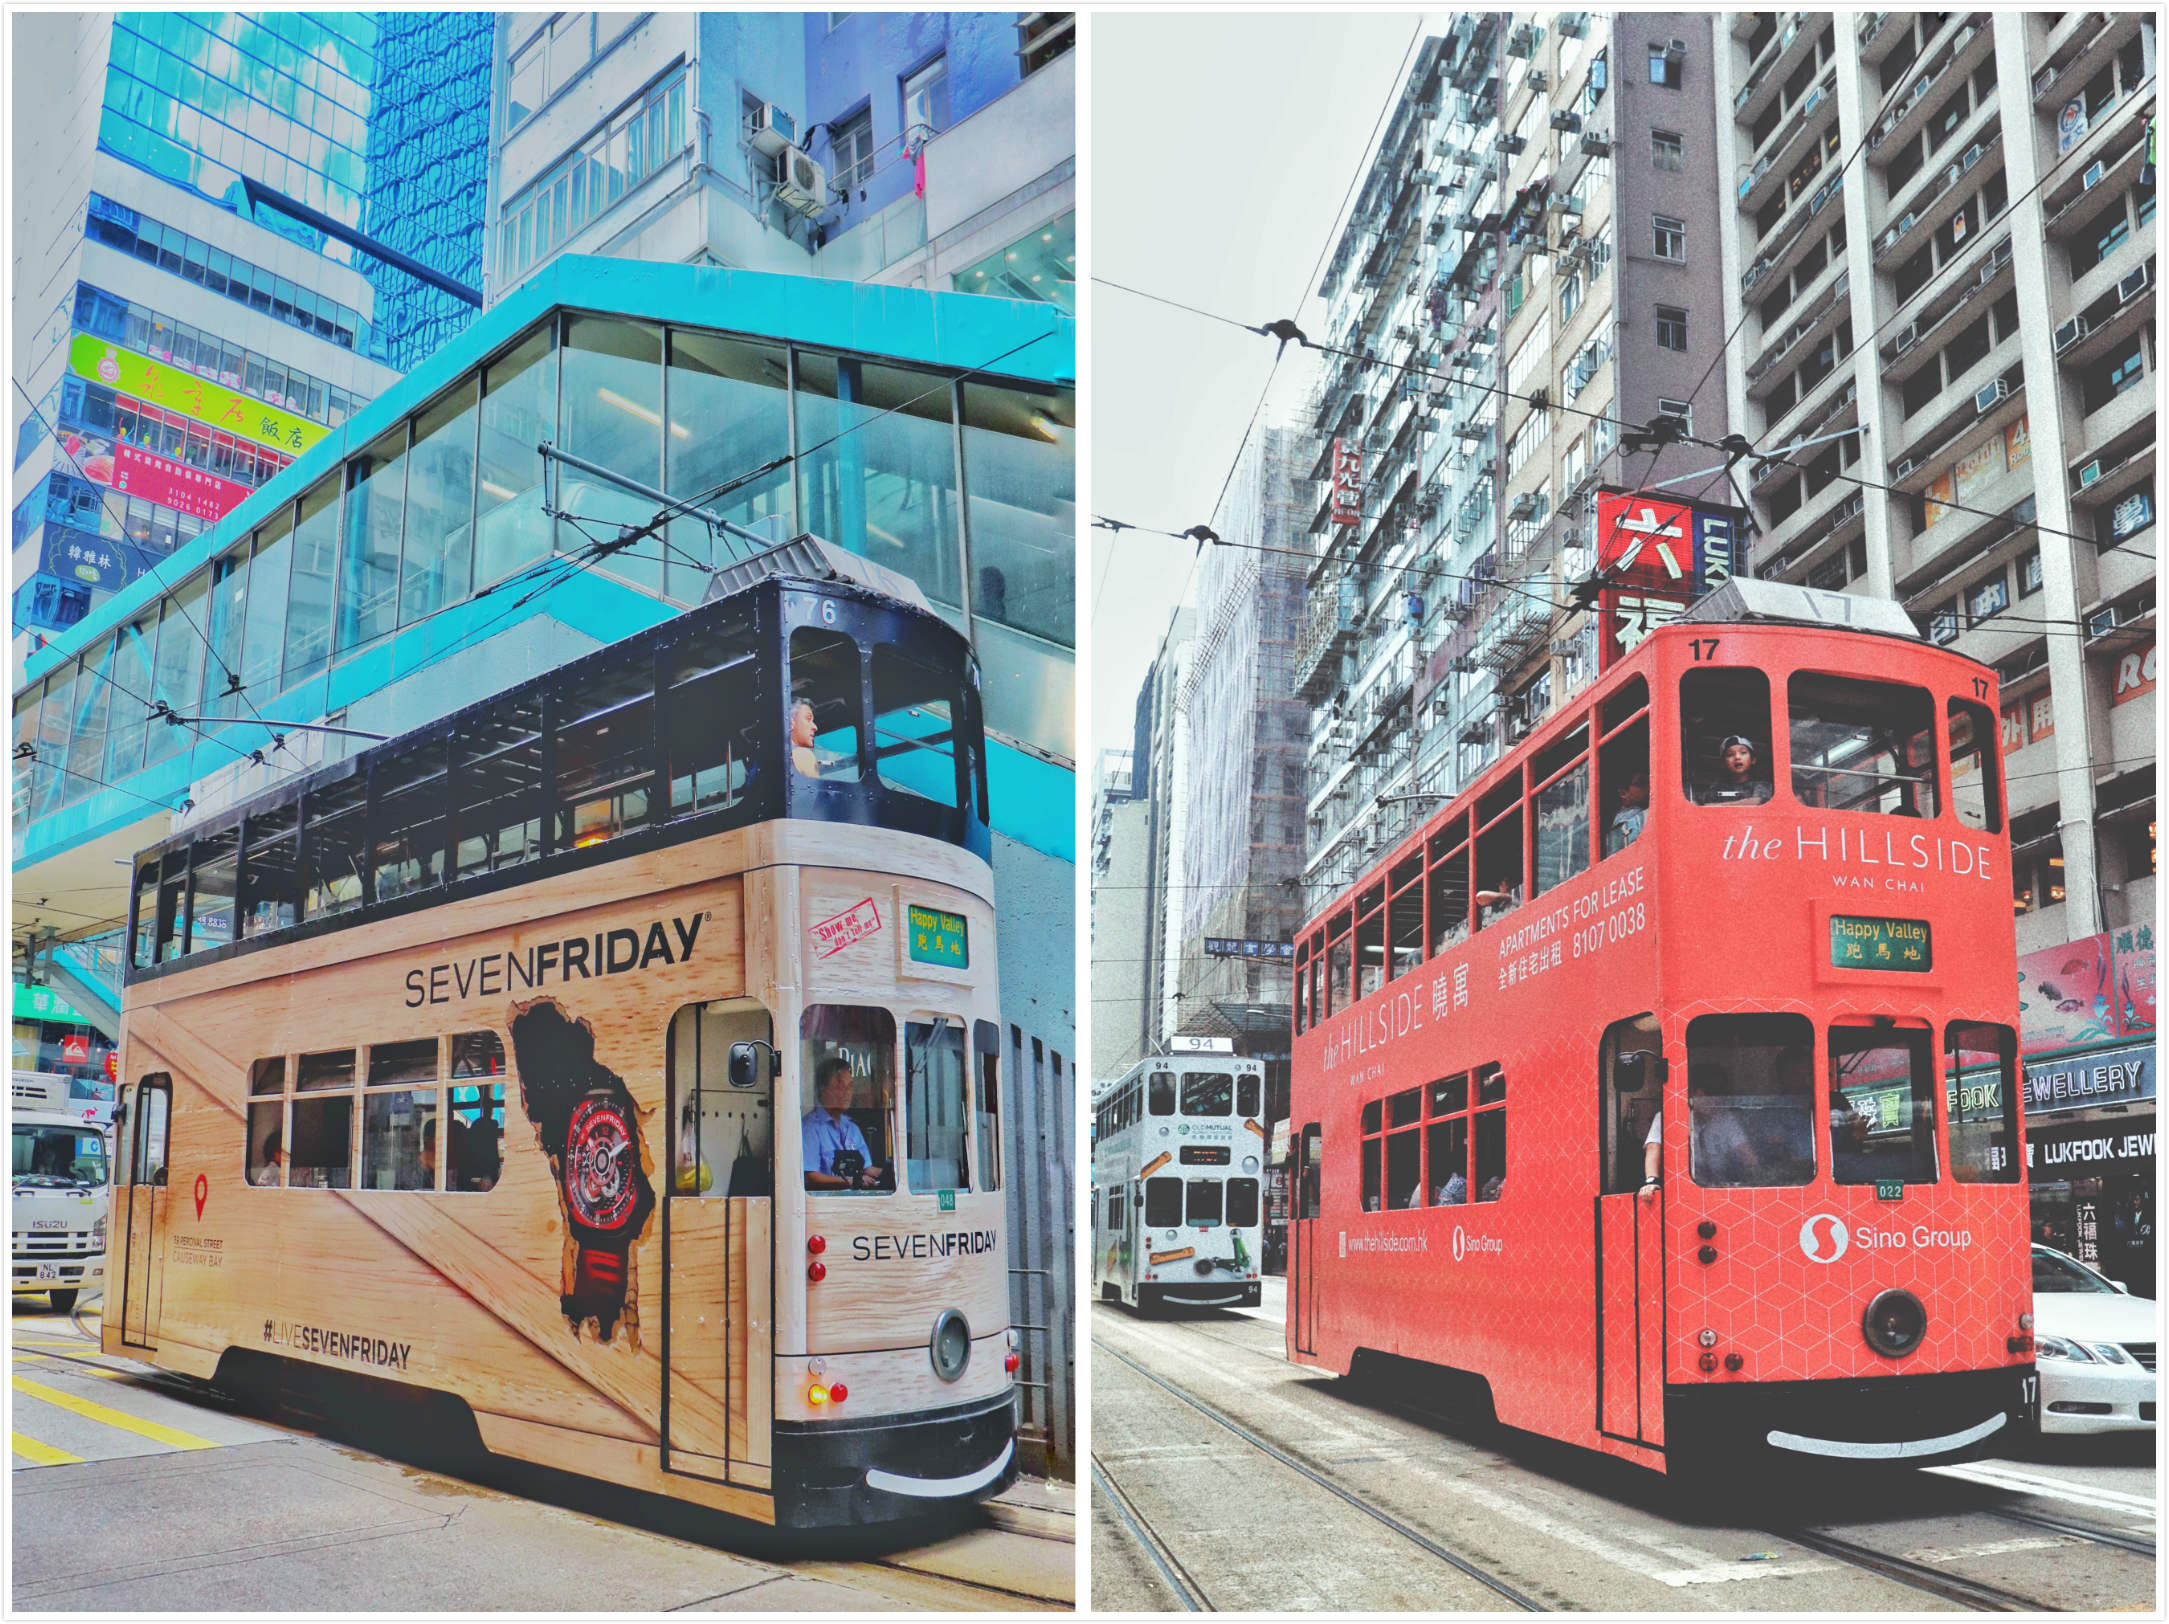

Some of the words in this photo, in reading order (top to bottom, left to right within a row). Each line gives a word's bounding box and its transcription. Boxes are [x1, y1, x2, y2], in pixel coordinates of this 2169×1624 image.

[803, 597, 837, 624] 76
[1688, 638, 1720, 661] 17
[1972, 677, 1988, 700] 17
[1722, 825, 1782, 860] the
[1796, 826, 1992, 880] HILLSIDE
[1832, 875, 1874, 889] WAN
[1885, 878, 1925, 893] CHAI
[911, 907, 938, 932] Happy
[940, 915, 965, 937] Valley
[1499, 906, 1569, 960] APARTMENTS
[1573, 891, 1599, 923] FOR
[1602, 866, 1644, 909] LEASE
[1835, 920, 1880, 941] Happy
[1885, 921, 1928, 941] Valley
[918, 933, 961, 955] 跑馬地
[1498, 940, 1562, 992] 全新住宅出租
[1572, 920, 1605, 959] 8107
[1608, 902, 1645, 943] 0038
[1846, 943, 1921, 961] 跑馬地
[405, 913, 704, 1008] SEVENFRIDAY
[1323, 1033, 1339, 1073] the
[1340, 984, 1423, 1063] HILLSIDE
[1432, 961, 1469, 1022] 曉寓
[1189, 1038, 1213, 1050] 94
[1156, 1062, 1168, 1070] 94
[1246, 1064, 1257, 1072] 94
[586, 1114, 627, 1137] SEVENFRIDAY
[2044, 1137, 2115, 1164] LUKFOOK
[2117, 1133, 2156, 1158] JEW
[1879, 1185, 1902, 1198] 022
[33, 1220, 68, 1229] ISUZU
[2083, 1202, 2098, 1260] 六福珠
[853, 1229, 997, 1262] SEVENFRIDAY
[1348, 1228, 1428, 1252] www.thehillside.com.hk
[1466, 1235, 1481, 1252] Sino
[1481, 1235, 1503, 1256] Group
[1855, 1227, 1906, 1250] Sino
[1912, 1226, 1972, 1251] Group
[1248, 1285, 1258, 1293] 94
[263, 1319, 411, 1370] #LIVESEVENFRIDAY
[2022, 1376, 2037, 1404] 17
